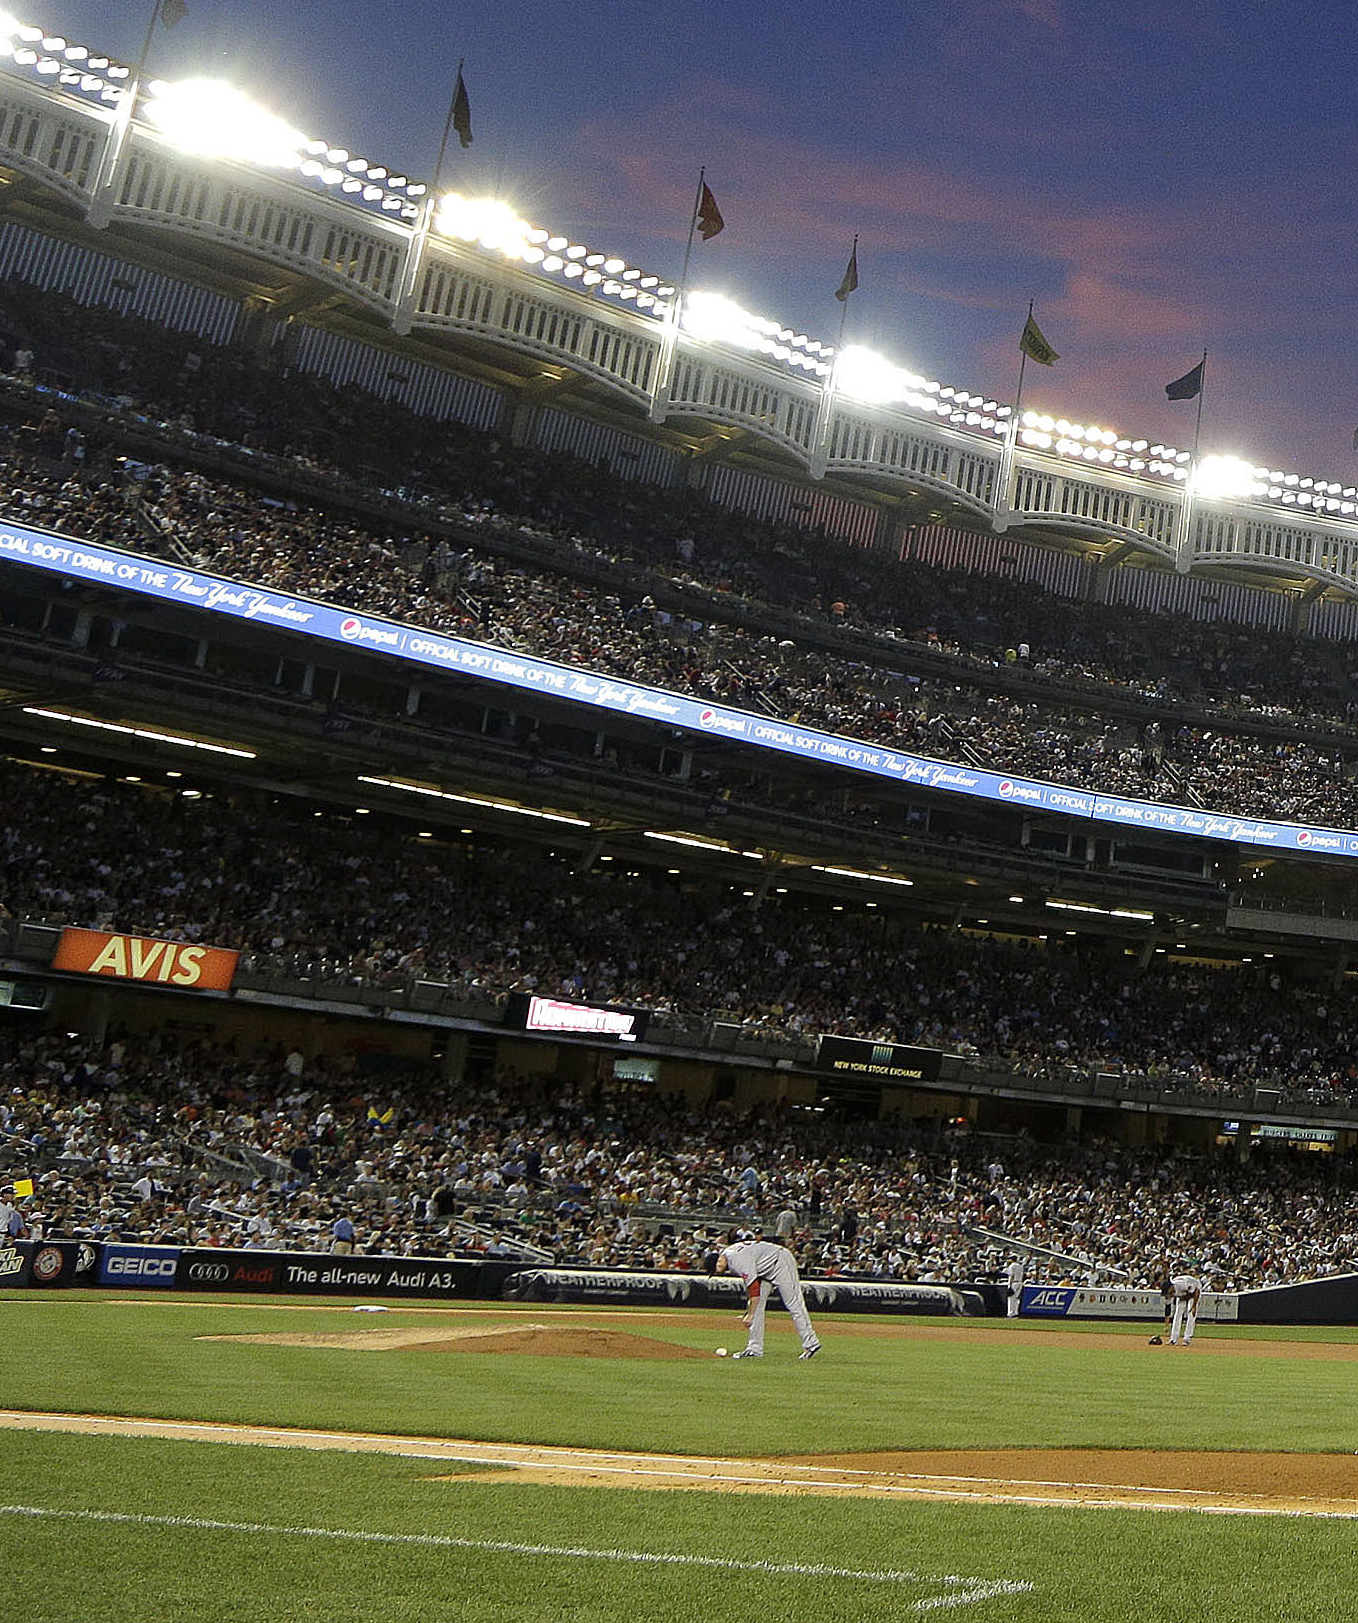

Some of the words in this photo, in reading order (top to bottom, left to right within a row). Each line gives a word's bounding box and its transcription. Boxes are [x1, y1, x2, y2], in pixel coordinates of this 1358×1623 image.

[33, 543, 72, 563] SOFT
[72, 552, 115, 575] DRINK
[140, 570, 168, 588] THE
[172, 573, 208, 597] New
[204, 583, 252, 607] York
[244, 595, 314, 623] Yankees
[359, 625, 398, 647] pepsi
[410, 639, 460, 663] OFFICIAL
[460, 651, 492, 670] SOFT
[492, 660, 526, 679] DRINK
[543, 672, 566, 689] THE
[568, 675, 601, 694] New
[595, 682, 630, 703] York
[626, 691, 681, 714] Yankees
[714, 715, 745, 736] pepsi
[754, 726, 795, 746] OFFICIAL
[795, 737, 821, 752] SOFT
[820, 741, 847, 759] DRINK
[861, 751, 879, 766] THE
[881, 754, 906, 771] New
[901, 760, 933, 780] York
[929, 766, 979, 787] Yankees
[1012, 787, 1041, 801] pepsi
[1050, 794, 1088, 810] OFFICIAL
[1088, 802, 1115, 816] SOFT
[1115, 805, 1144, 821] DRINK
[1158, 813, 1176, 825] THE
[1180, 812, 1204, 829] New
[1200, 817, 1232, 836] York
[1229, 822, 1279, 841] Yankees
[1310, 836, 1341, 849] pepsi
[88, 935, 206, 986] AVIS
[834, 1061, 850, 1070] NEW
[850, 1063, 866, 1073] YORK
[868, 1065, 888, 1075] STOCK
[890, 1068, 922, 1079] EXCHANGE
[107, 1256, 177, 1275] GEICO
[233, 1266, 275, 1282] Audi
[287, 1266, 317, 1283] The
[320, 1268, 381, 1285] all-new
[387, 1270, 426, 1288] Audi
[428, 1273, 456, 1289] A3.
[544, 1273, 665, 1290] WEATHERPROOF
[1029, 1290, 1069, 1306] ACC
